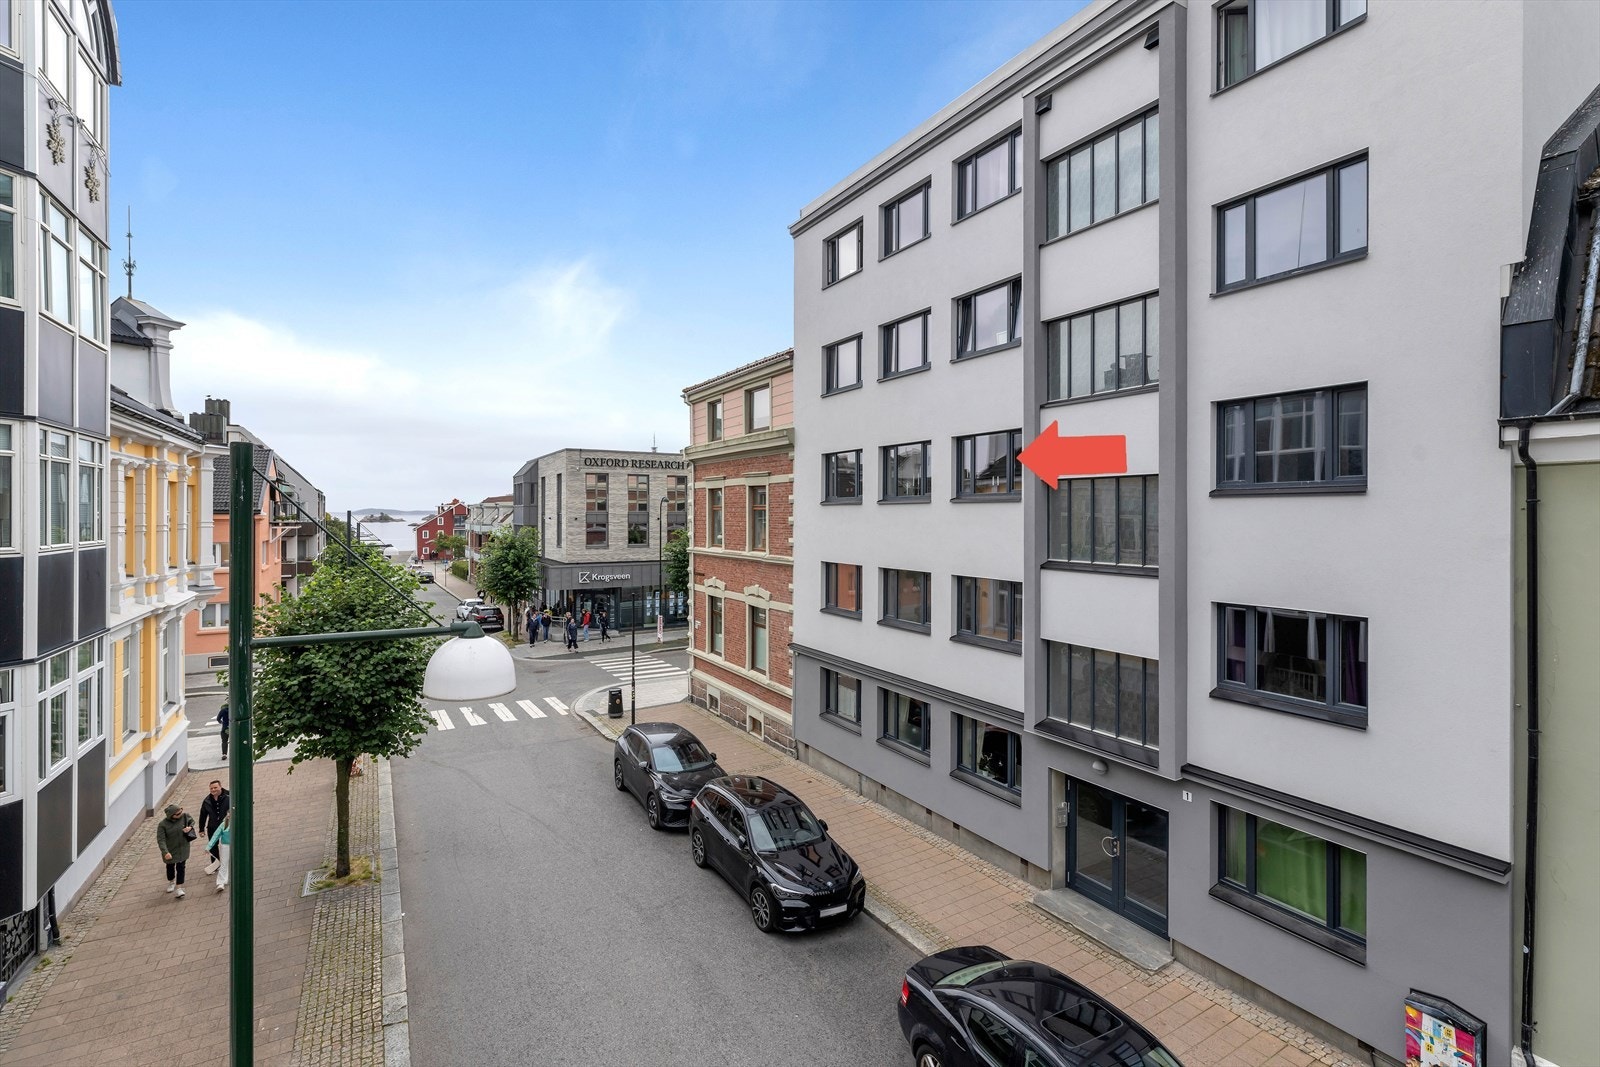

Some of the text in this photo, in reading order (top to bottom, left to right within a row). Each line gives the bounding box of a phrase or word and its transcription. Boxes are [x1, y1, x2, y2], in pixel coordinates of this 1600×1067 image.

[584, 457, 629, 468] OXFORD
[631, 459, 685, 470] RESEARCH
[592, 573, 630, 583] Krogsveen
